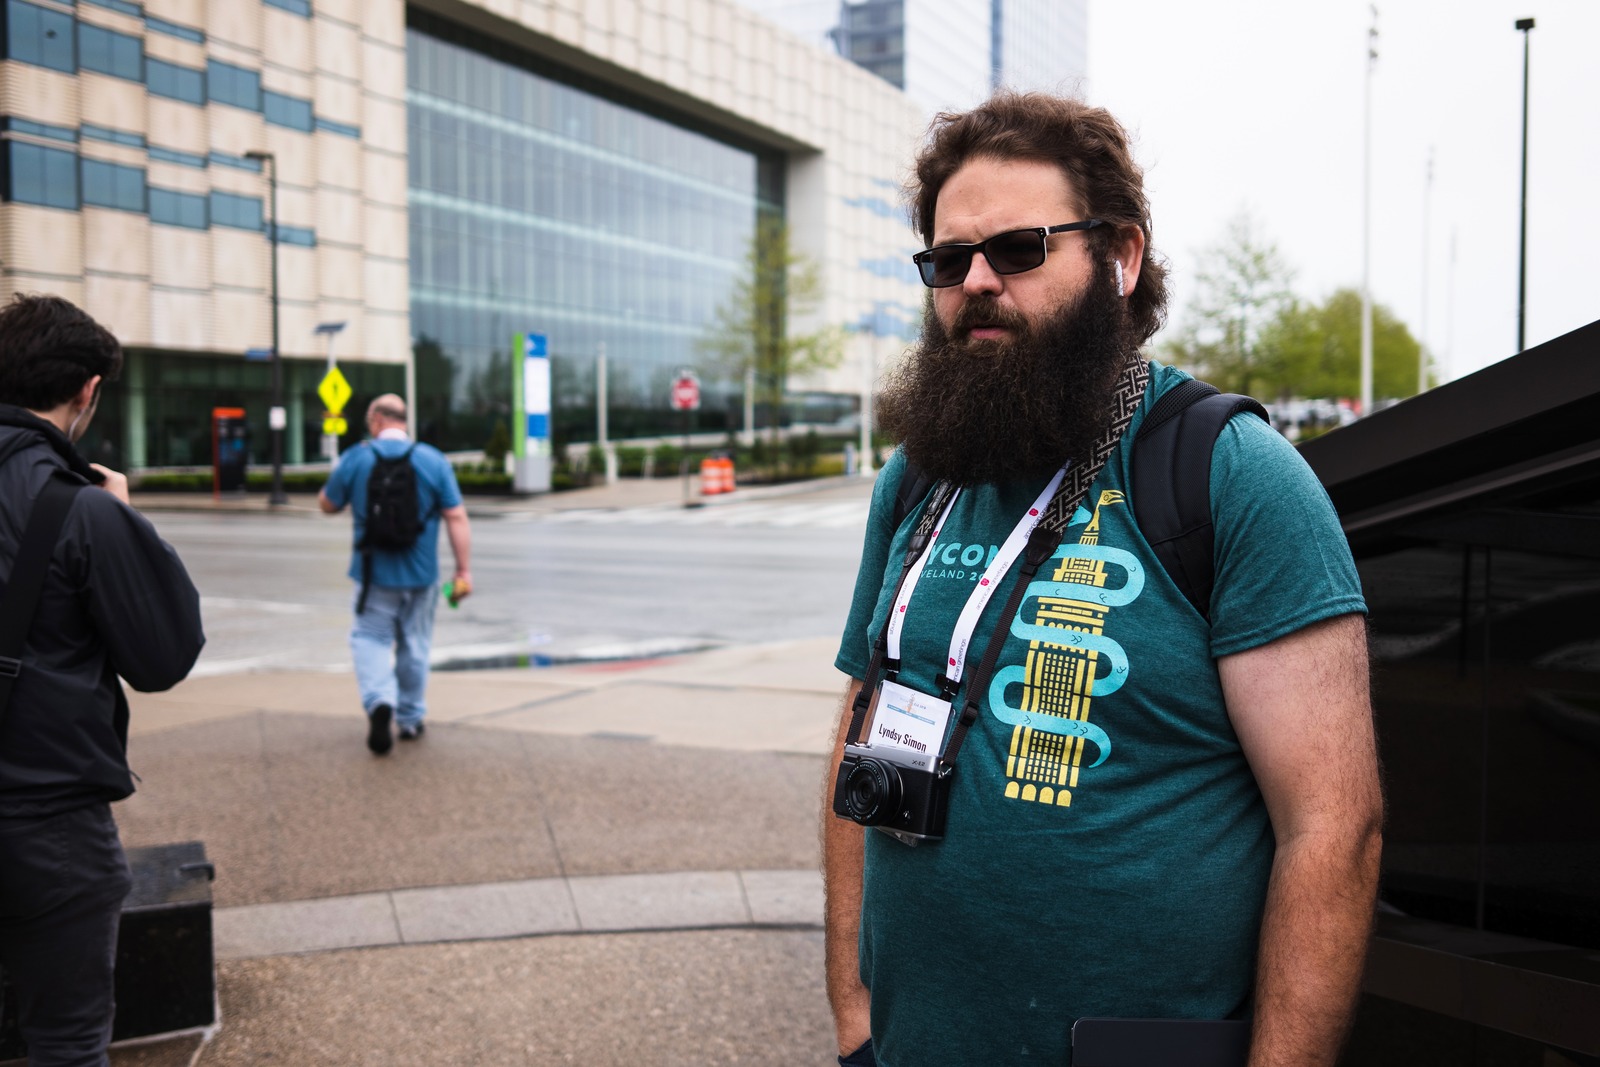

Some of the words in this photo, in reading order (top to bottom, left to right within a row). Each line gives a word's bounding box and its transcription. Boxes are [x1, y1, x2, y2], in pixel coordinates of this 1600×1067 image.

[920, 569, 965, 580] VELAND
[879, 723, 902, 744] Lyndsy
[903, 733, 927, 754] Simon
